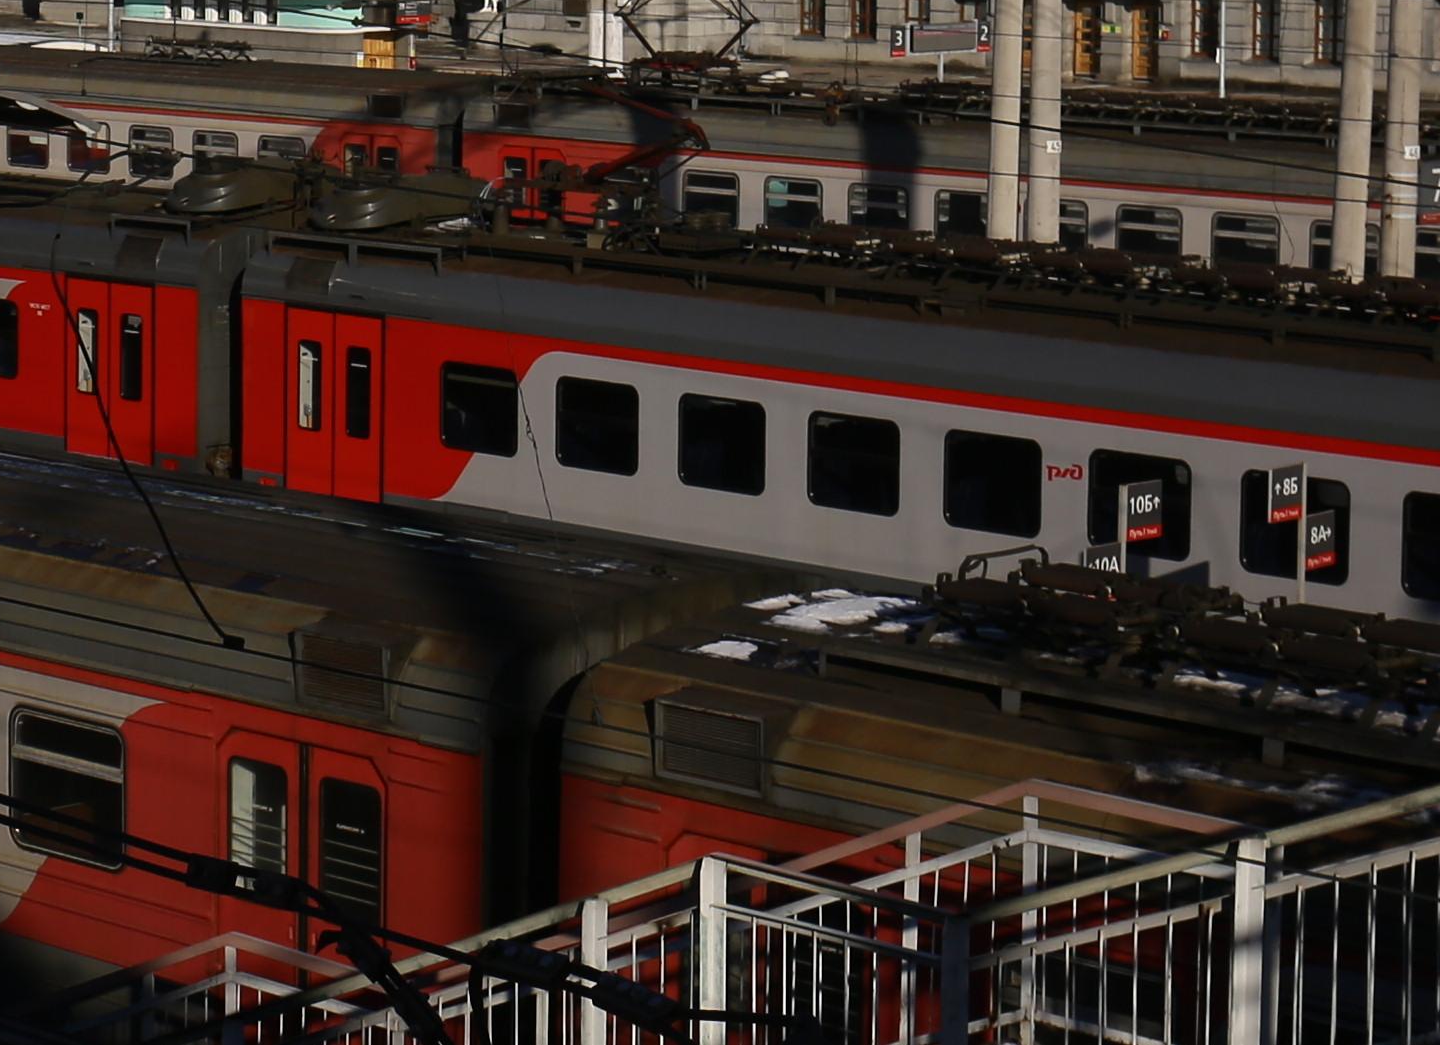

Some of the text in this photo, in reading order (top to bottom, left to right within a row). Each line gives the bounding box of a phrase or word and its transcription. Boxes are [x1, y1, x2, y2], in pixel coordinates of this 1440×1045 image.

[894, 30, 903, 47] 3
[979, 24, 989, 42] 2
[1282, 477, 1299, 496] 8Б
[1129, 494, 1154, 515] 10Б
[1310, 525, 1328, 545] 8А
